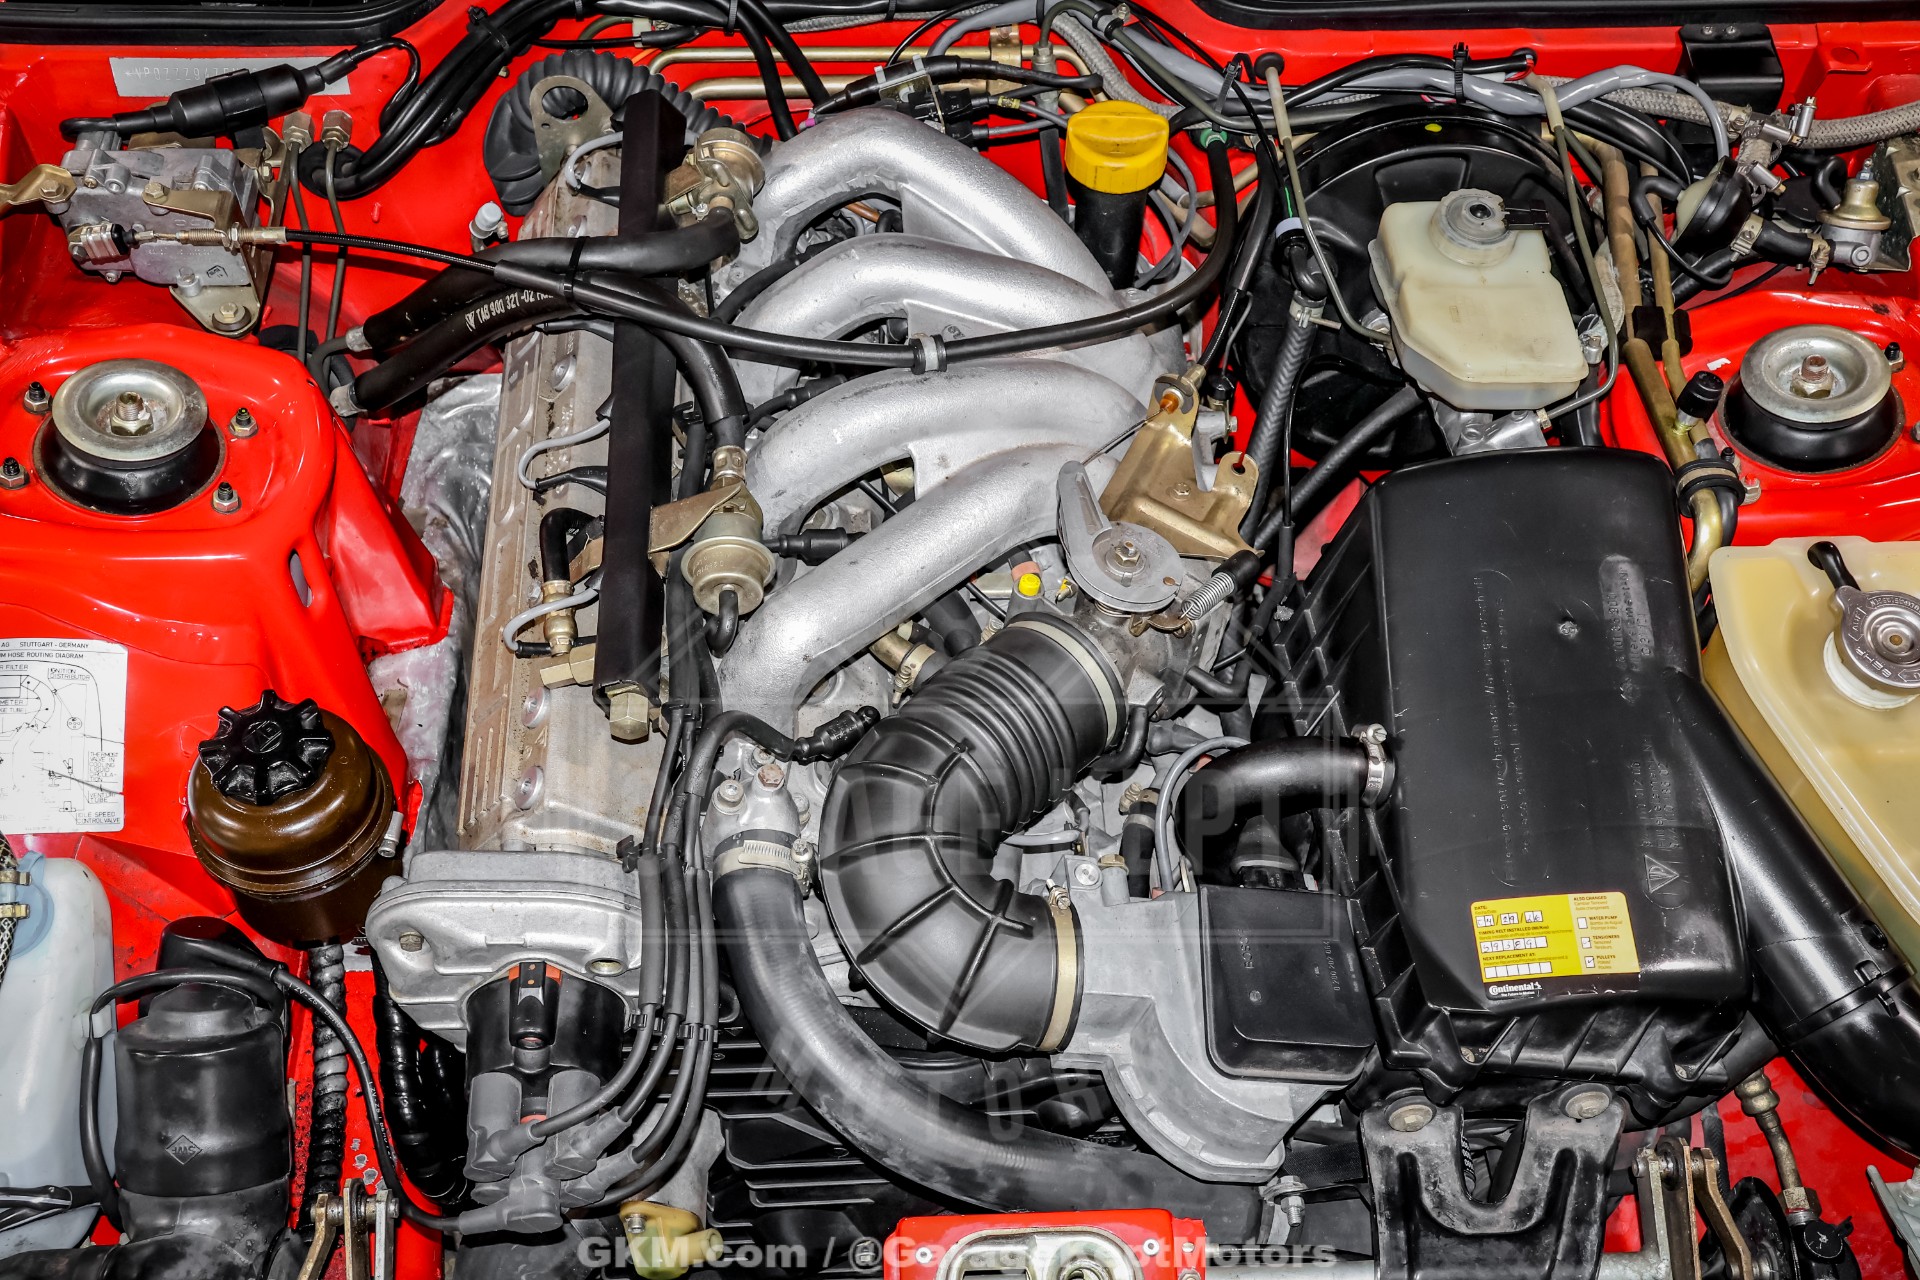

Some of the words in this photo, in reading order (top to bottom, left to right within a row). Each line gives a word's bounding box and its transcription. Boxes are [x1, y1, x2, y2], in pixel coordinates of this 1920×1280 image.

[476, 303, 491, 324] TAB
[490, 298, 505, 316] 900
[506, 292, 520, 310] 321
[1856, 646, 1892, 678] BEHR
[1488, 982, 1535, 996] Continental
[171, 1145, 197, 1154] SWF
